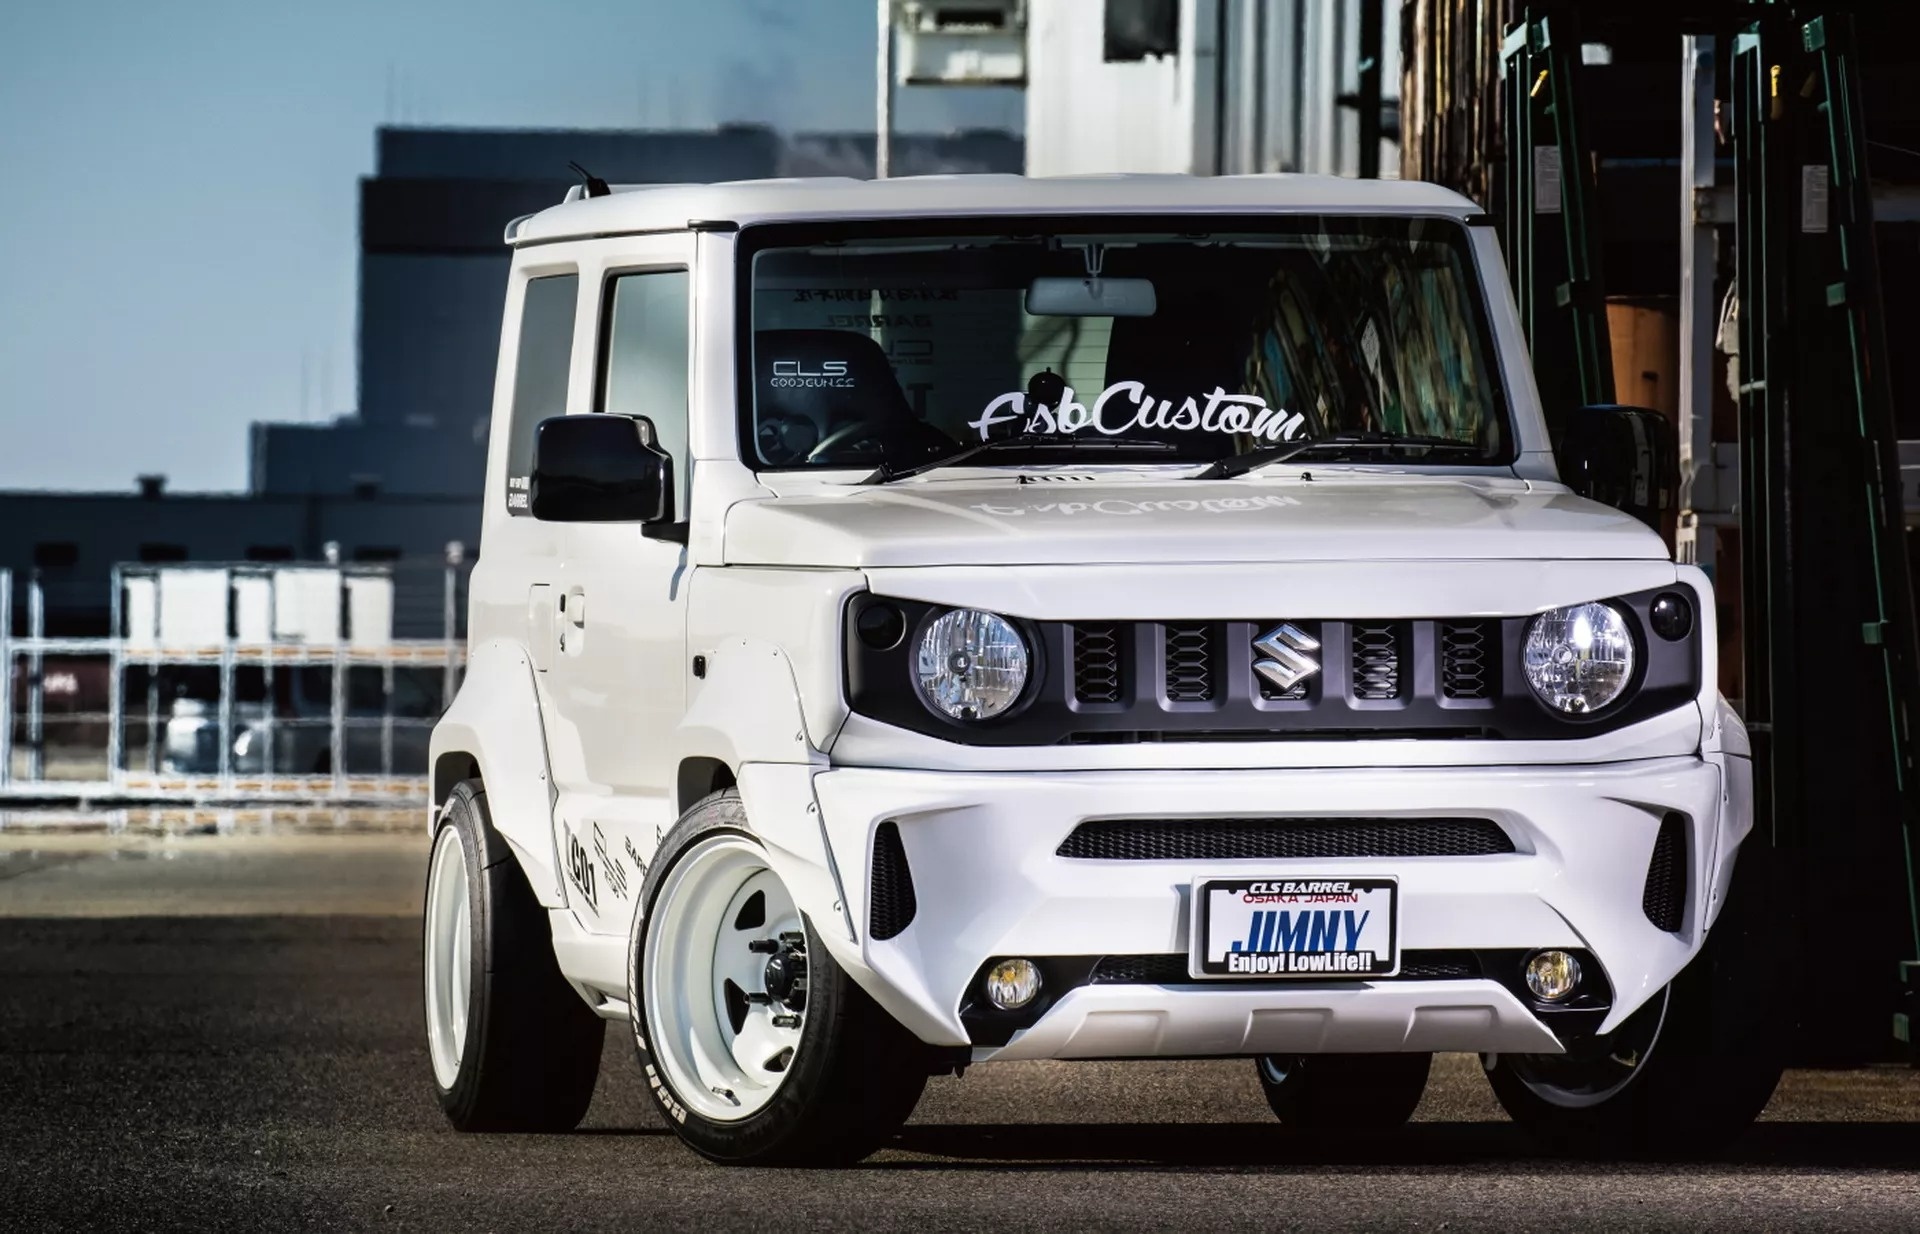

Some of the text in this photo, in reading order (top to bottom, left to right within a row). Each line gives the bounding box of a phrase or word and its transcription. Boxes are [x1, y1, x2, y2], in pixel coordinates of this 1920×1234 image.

[772, 361, 848, 376] CLS
[1249, 882, 1352, 894] CLS BARREL
[1242, 893, 1358, 904] OSAKA JAPAN
[1231, 910, 1371, 953] JIMNY
[1228, 952, 1372, 974] Enjoy! LowLife!!
